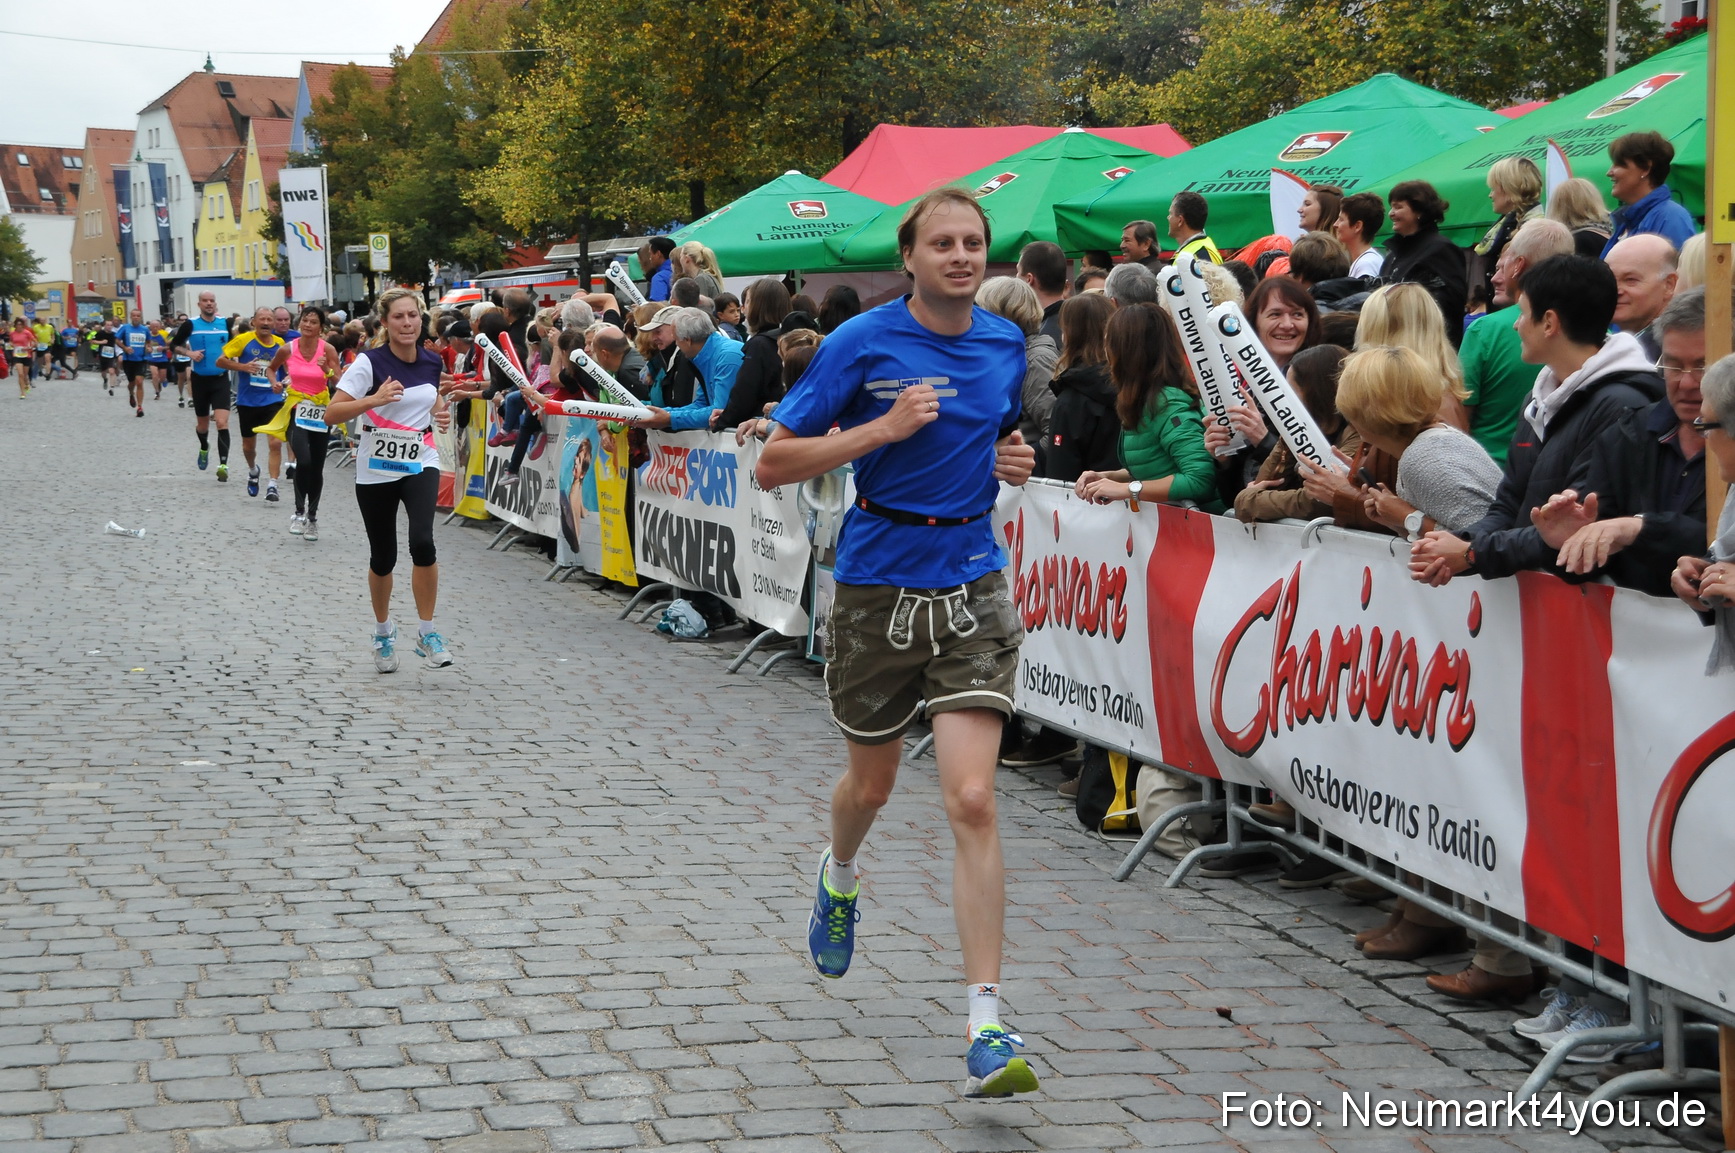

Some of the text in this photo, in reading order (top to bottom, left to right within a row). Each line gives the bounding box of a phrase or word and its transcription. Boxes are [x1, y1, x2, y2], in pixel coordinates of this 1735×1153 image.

[1179, 307, 1205, 353] BMW
[489, 349, 509, 368] BMW
[300, 406, 326, 420] 2487
[589, 367, 638, 409] bmw-laufspo
[1237, 344, 1334, 473] BMW Laufspo
[375, 440, 419, 460] 2918
[382, 462, 410, 472] Claudia
[647, 445, 739, 509] INTERSPORT
[1003, 507, 1134, 644] harivari
[1210, 560, 1481, 758] Charivari
[1023, 658, 1144, 730] Ostbayerns Radio
[1290, 757, 1496, 872] Ostbayerns Radio
